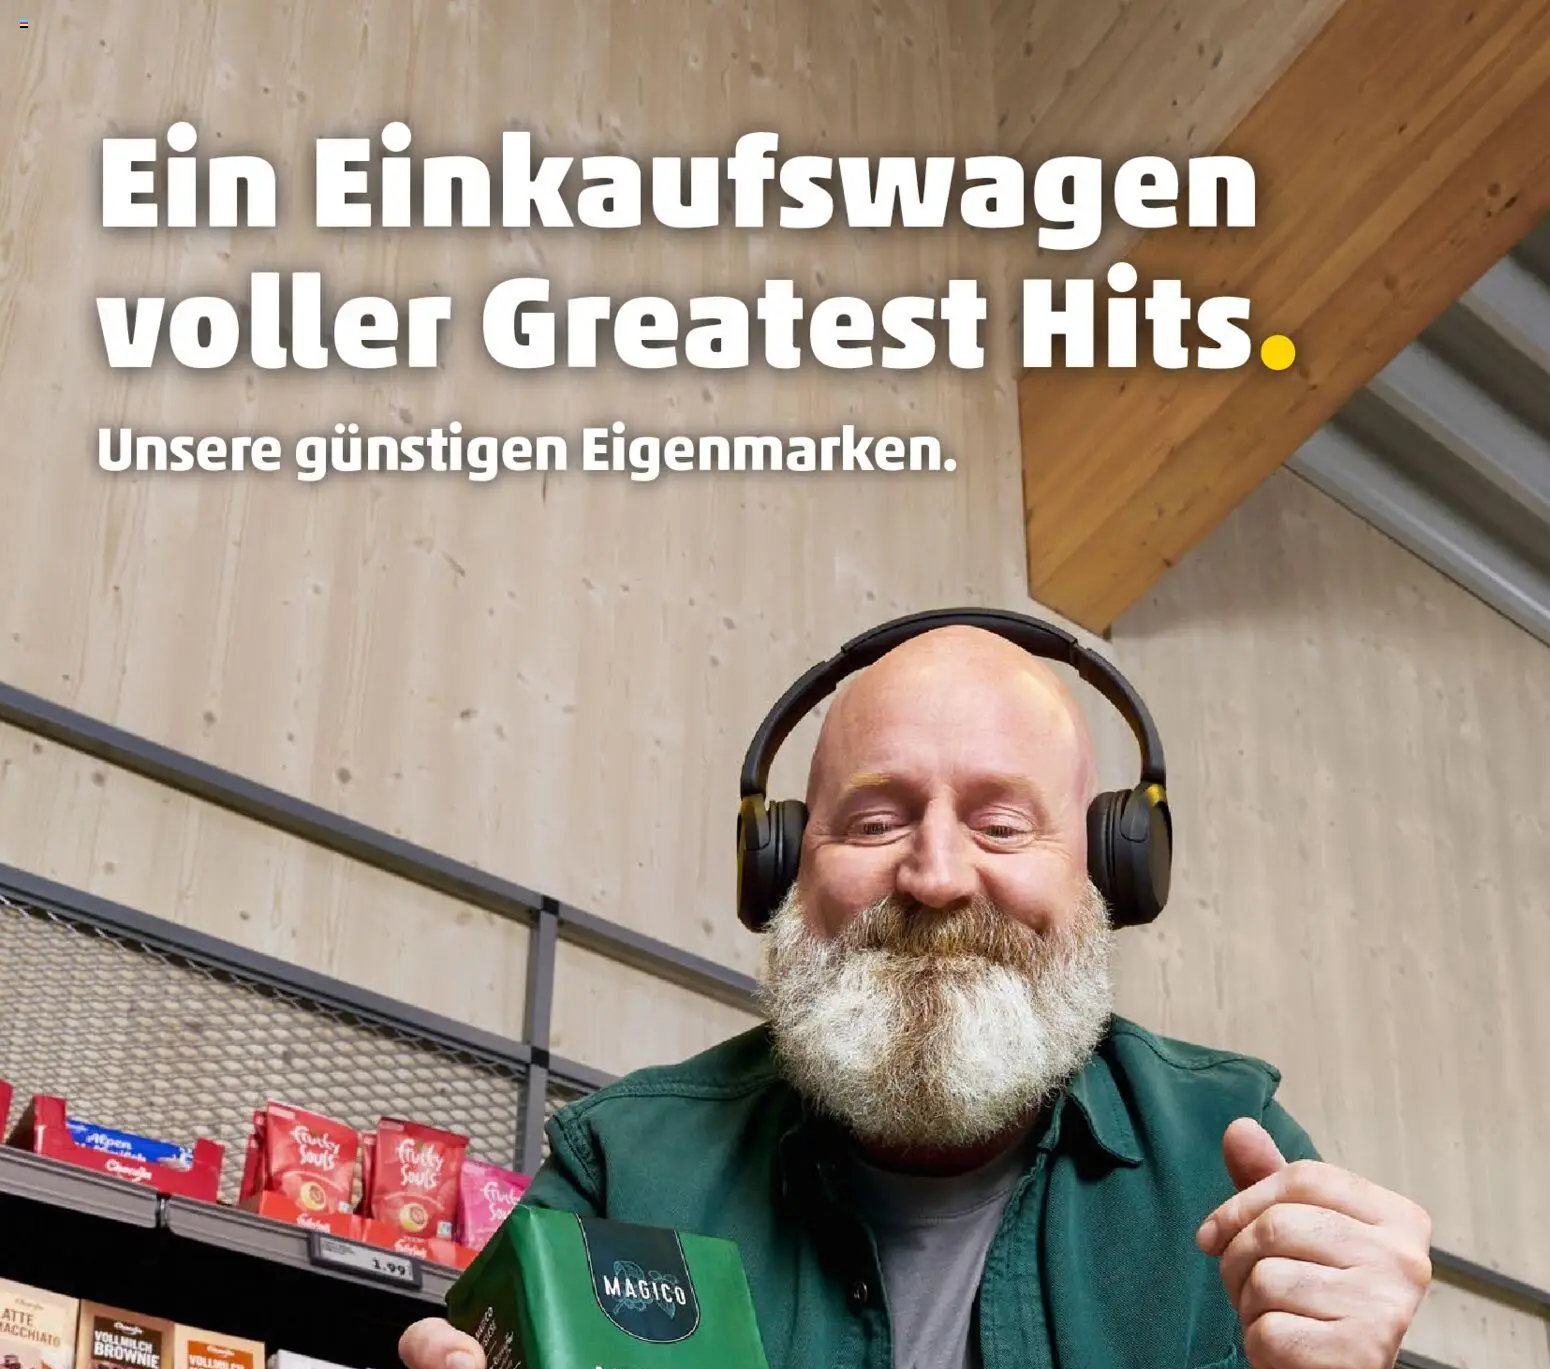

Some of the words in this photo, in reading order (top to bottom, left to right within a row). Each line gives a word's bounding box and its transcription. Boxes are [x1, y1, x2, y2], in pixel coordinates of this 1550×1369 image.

[86, 1132, 133, 1151] Alpen
[370, 1256, 406, 1276] 1.99
[603, 1274, 687, 1305] MAGICO
[1, 1307, 34, 1327] ATTE
[94, 1331, 153, 1353] VOLLMILCH
